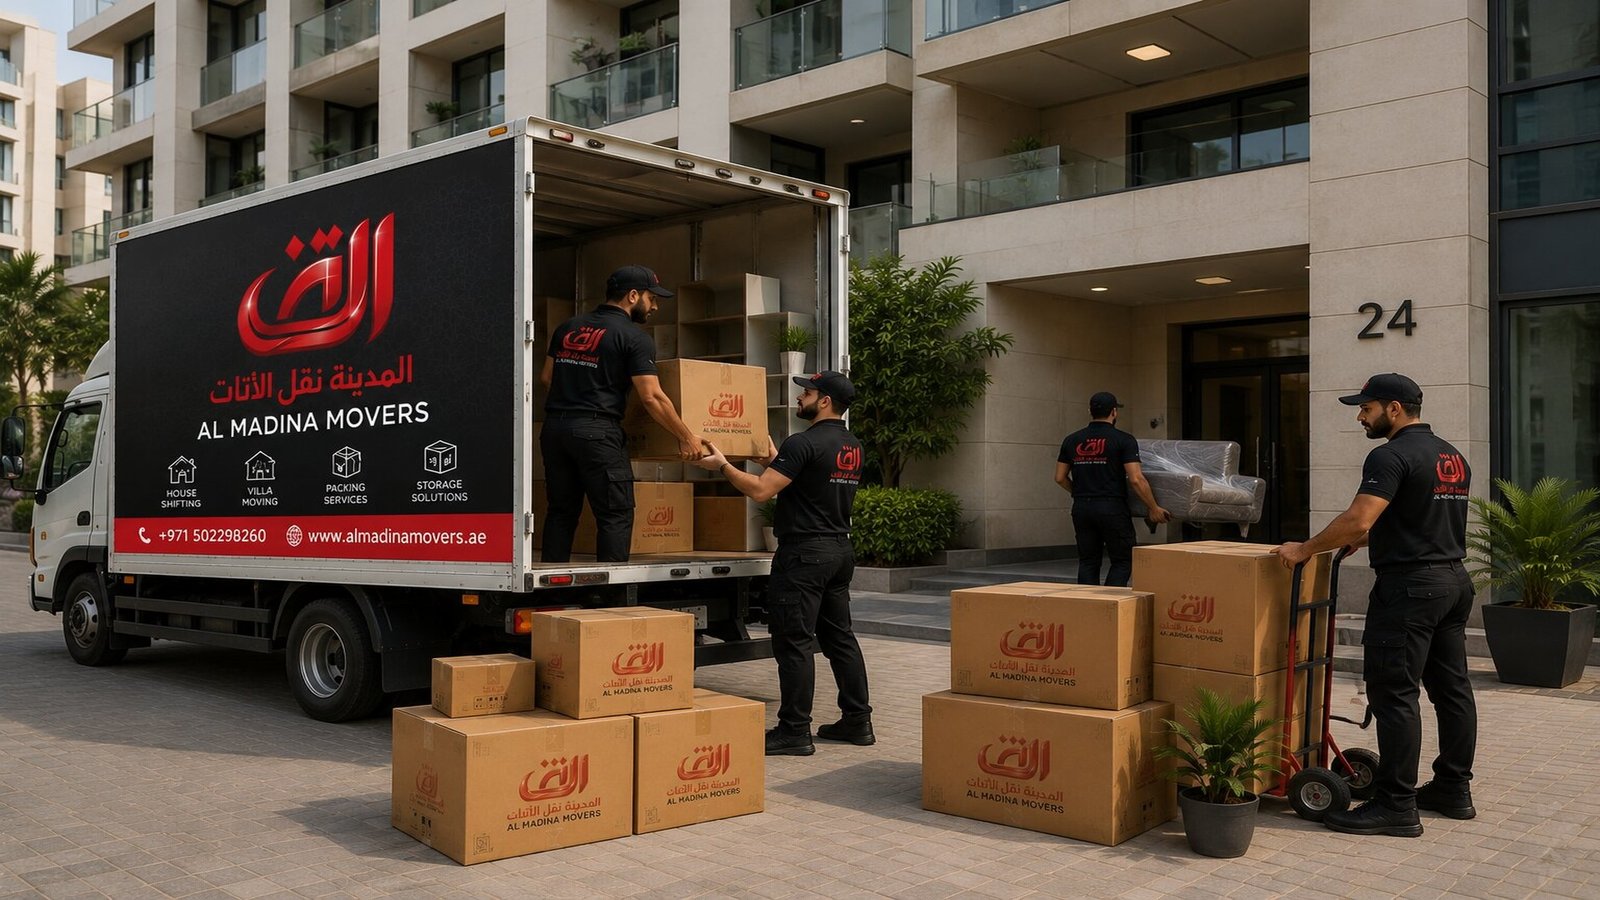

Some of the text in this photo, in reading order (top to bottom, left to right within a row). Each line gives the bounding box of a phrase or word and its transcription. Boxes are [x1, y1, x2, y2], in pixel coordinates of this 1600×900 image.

[1357, 299, 1417, 339] 24
[330, 354, 413, 396] المدينة
[277, 367, 323, 406] نقل
[197, 401, 429, 440] AL MADINA MOVERS
[247, 486, 273, 496] VILLA
[325, 483, 366, 493] PACKING
[416, 479, 463, 490] STORAGE
[166, 489, 197, 498] HOUSE
[323, 495, 368, 505] SERVICES
[411, 492, 468, 503] SOLUTIONS
[161, 499, 202, 508] SHIFTING
[242, 497, 278, 507] MOVING
[159, 528, 267, 543] +971 502298260
[308, 527, 487, 545] www.almadinamovers.ae
[966, 789, 979, 799] AL
[1021, 799, 1064, 814] MOVERS
[507, 810, 601, 831] AL MADINA MOVERS
